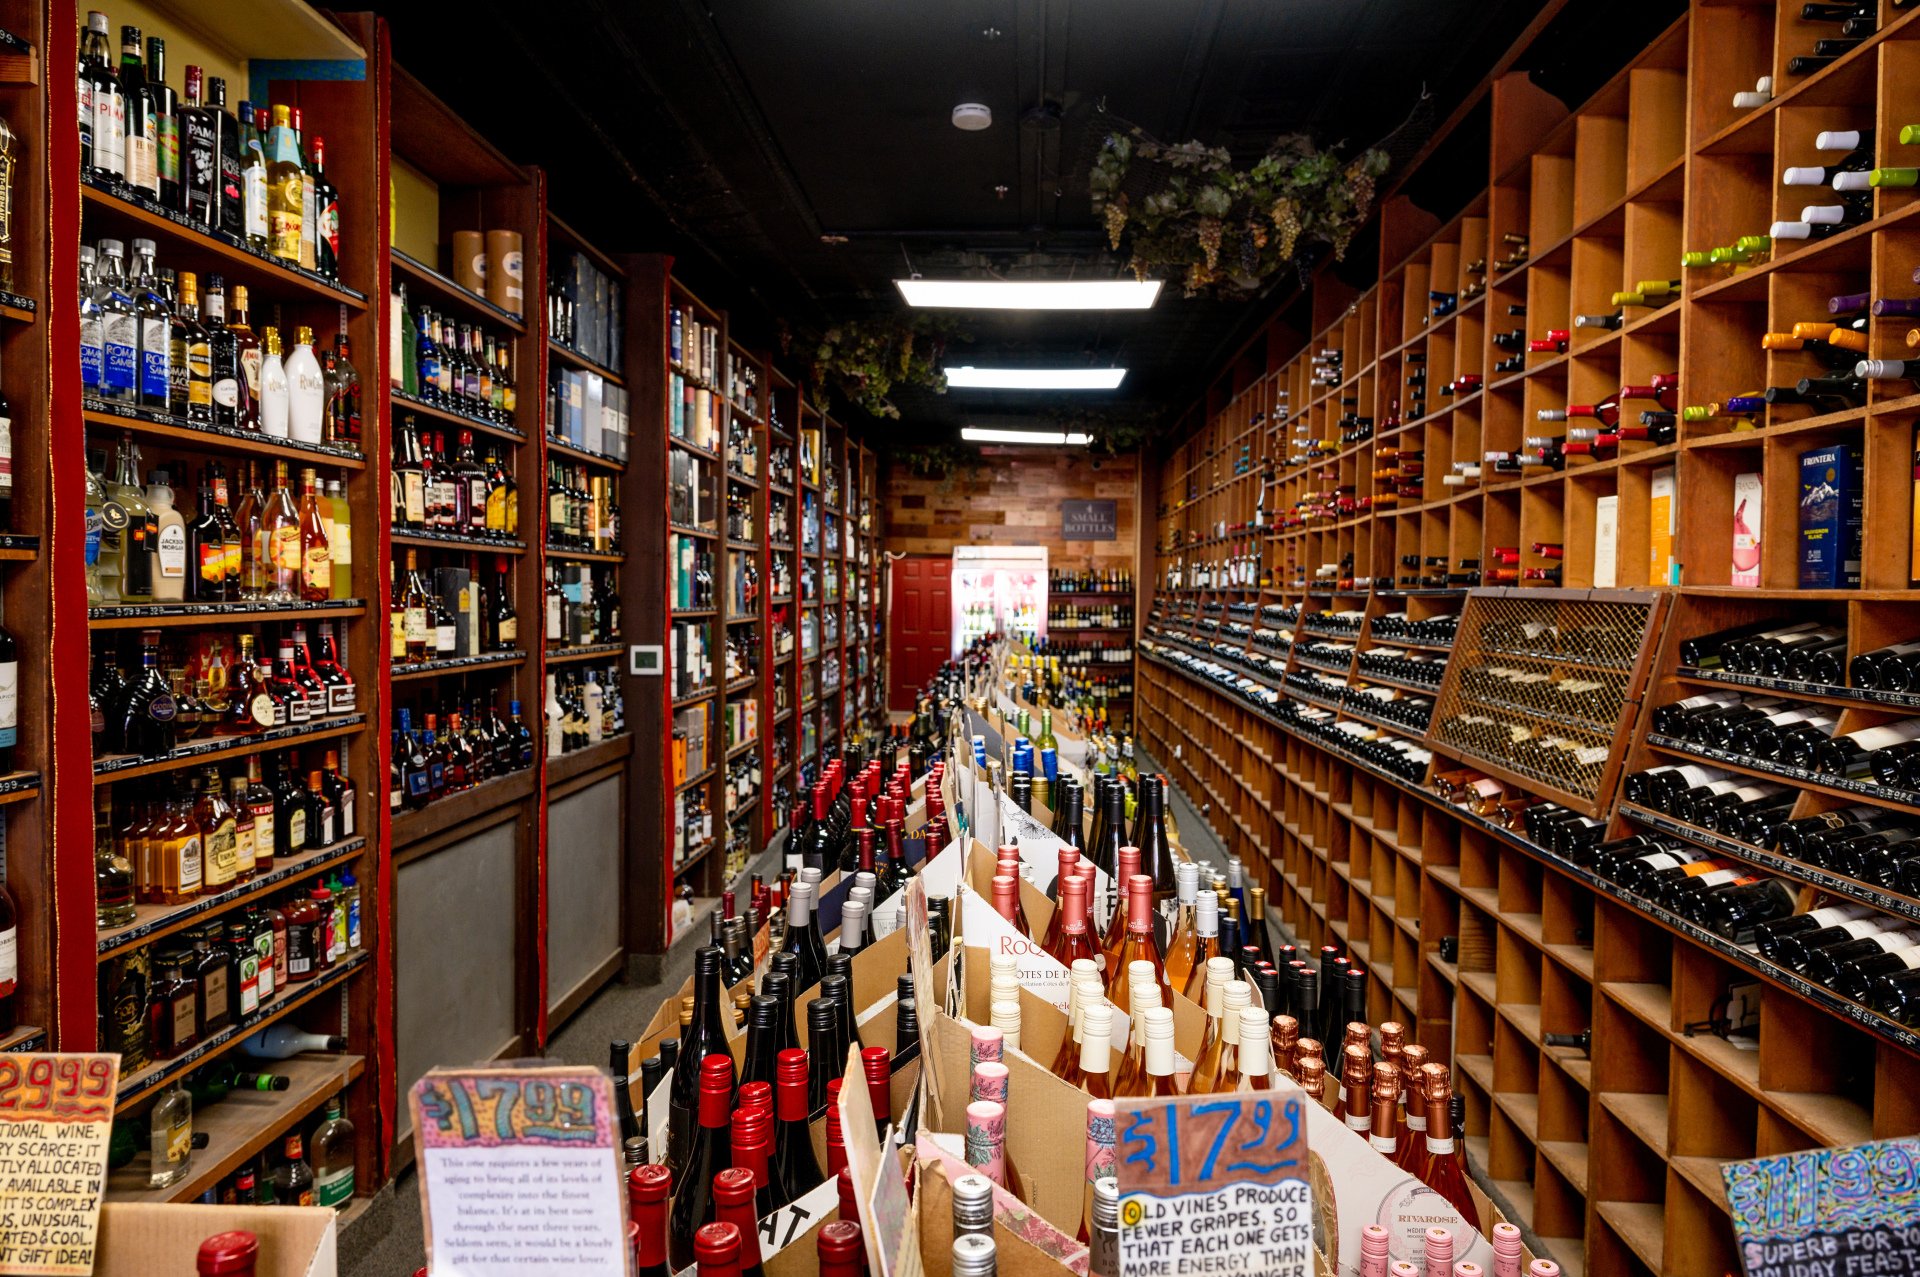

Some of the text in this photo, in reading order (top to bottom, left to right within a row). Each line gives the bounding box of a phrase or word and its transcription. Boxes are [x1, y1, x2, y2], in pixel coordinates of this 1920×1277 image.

[1803, 453, 1836, 467] FRONTERA
[1071, 513, 1107, 522] SMALL
[1064, 523, 1115, 533] BOTTLES
[1016, 967, 1042, 979] ÔTES
[1046, 970, 1059, 979] DE
[419, 1079, 597, 1140] $1799
[56, 1124, 100, 1139] WINE,
[18, 1142, 82, 1157] SCARCE:
[86, 1144, 101, 1157] IT
[1123, 1100, 1300, 1185] $1799
[26, 1159, 103, 1176] ALLOCATED
[5, 1178, 101, 1194] AVAILABLE IN
[1732, 1147, 1917, 1230] $1199
[21, 1197, 34, 1210] IS
[36, 1197, 96, 1212] COMPLEX
[1122, 1186, 1308, 1226] OLD VINES PRODUCE
[21, 1213, 93, 1230] UNUSUAL,
[1122, 1220, 1184, 1242] FEWER
[1273, 1206, 1298, 1224] SO
[1397, 1214, 1459, 1225] RIVAROSE
[0, 1229, 93, 1246] ATED & COOL.
[1123, 1224, 1309, 1259] THAT EACH ONE GETS
[18, 1249, 52, 1264] GIFT
[55, 1249, 92, 1264] IDEA!
[1744, 1235, 1839, 1270] SUPERB
[1847, 1230, 1892, 1251] FOR
[1123, 1245, 1307, 1277] MORE ENERGY THAN
